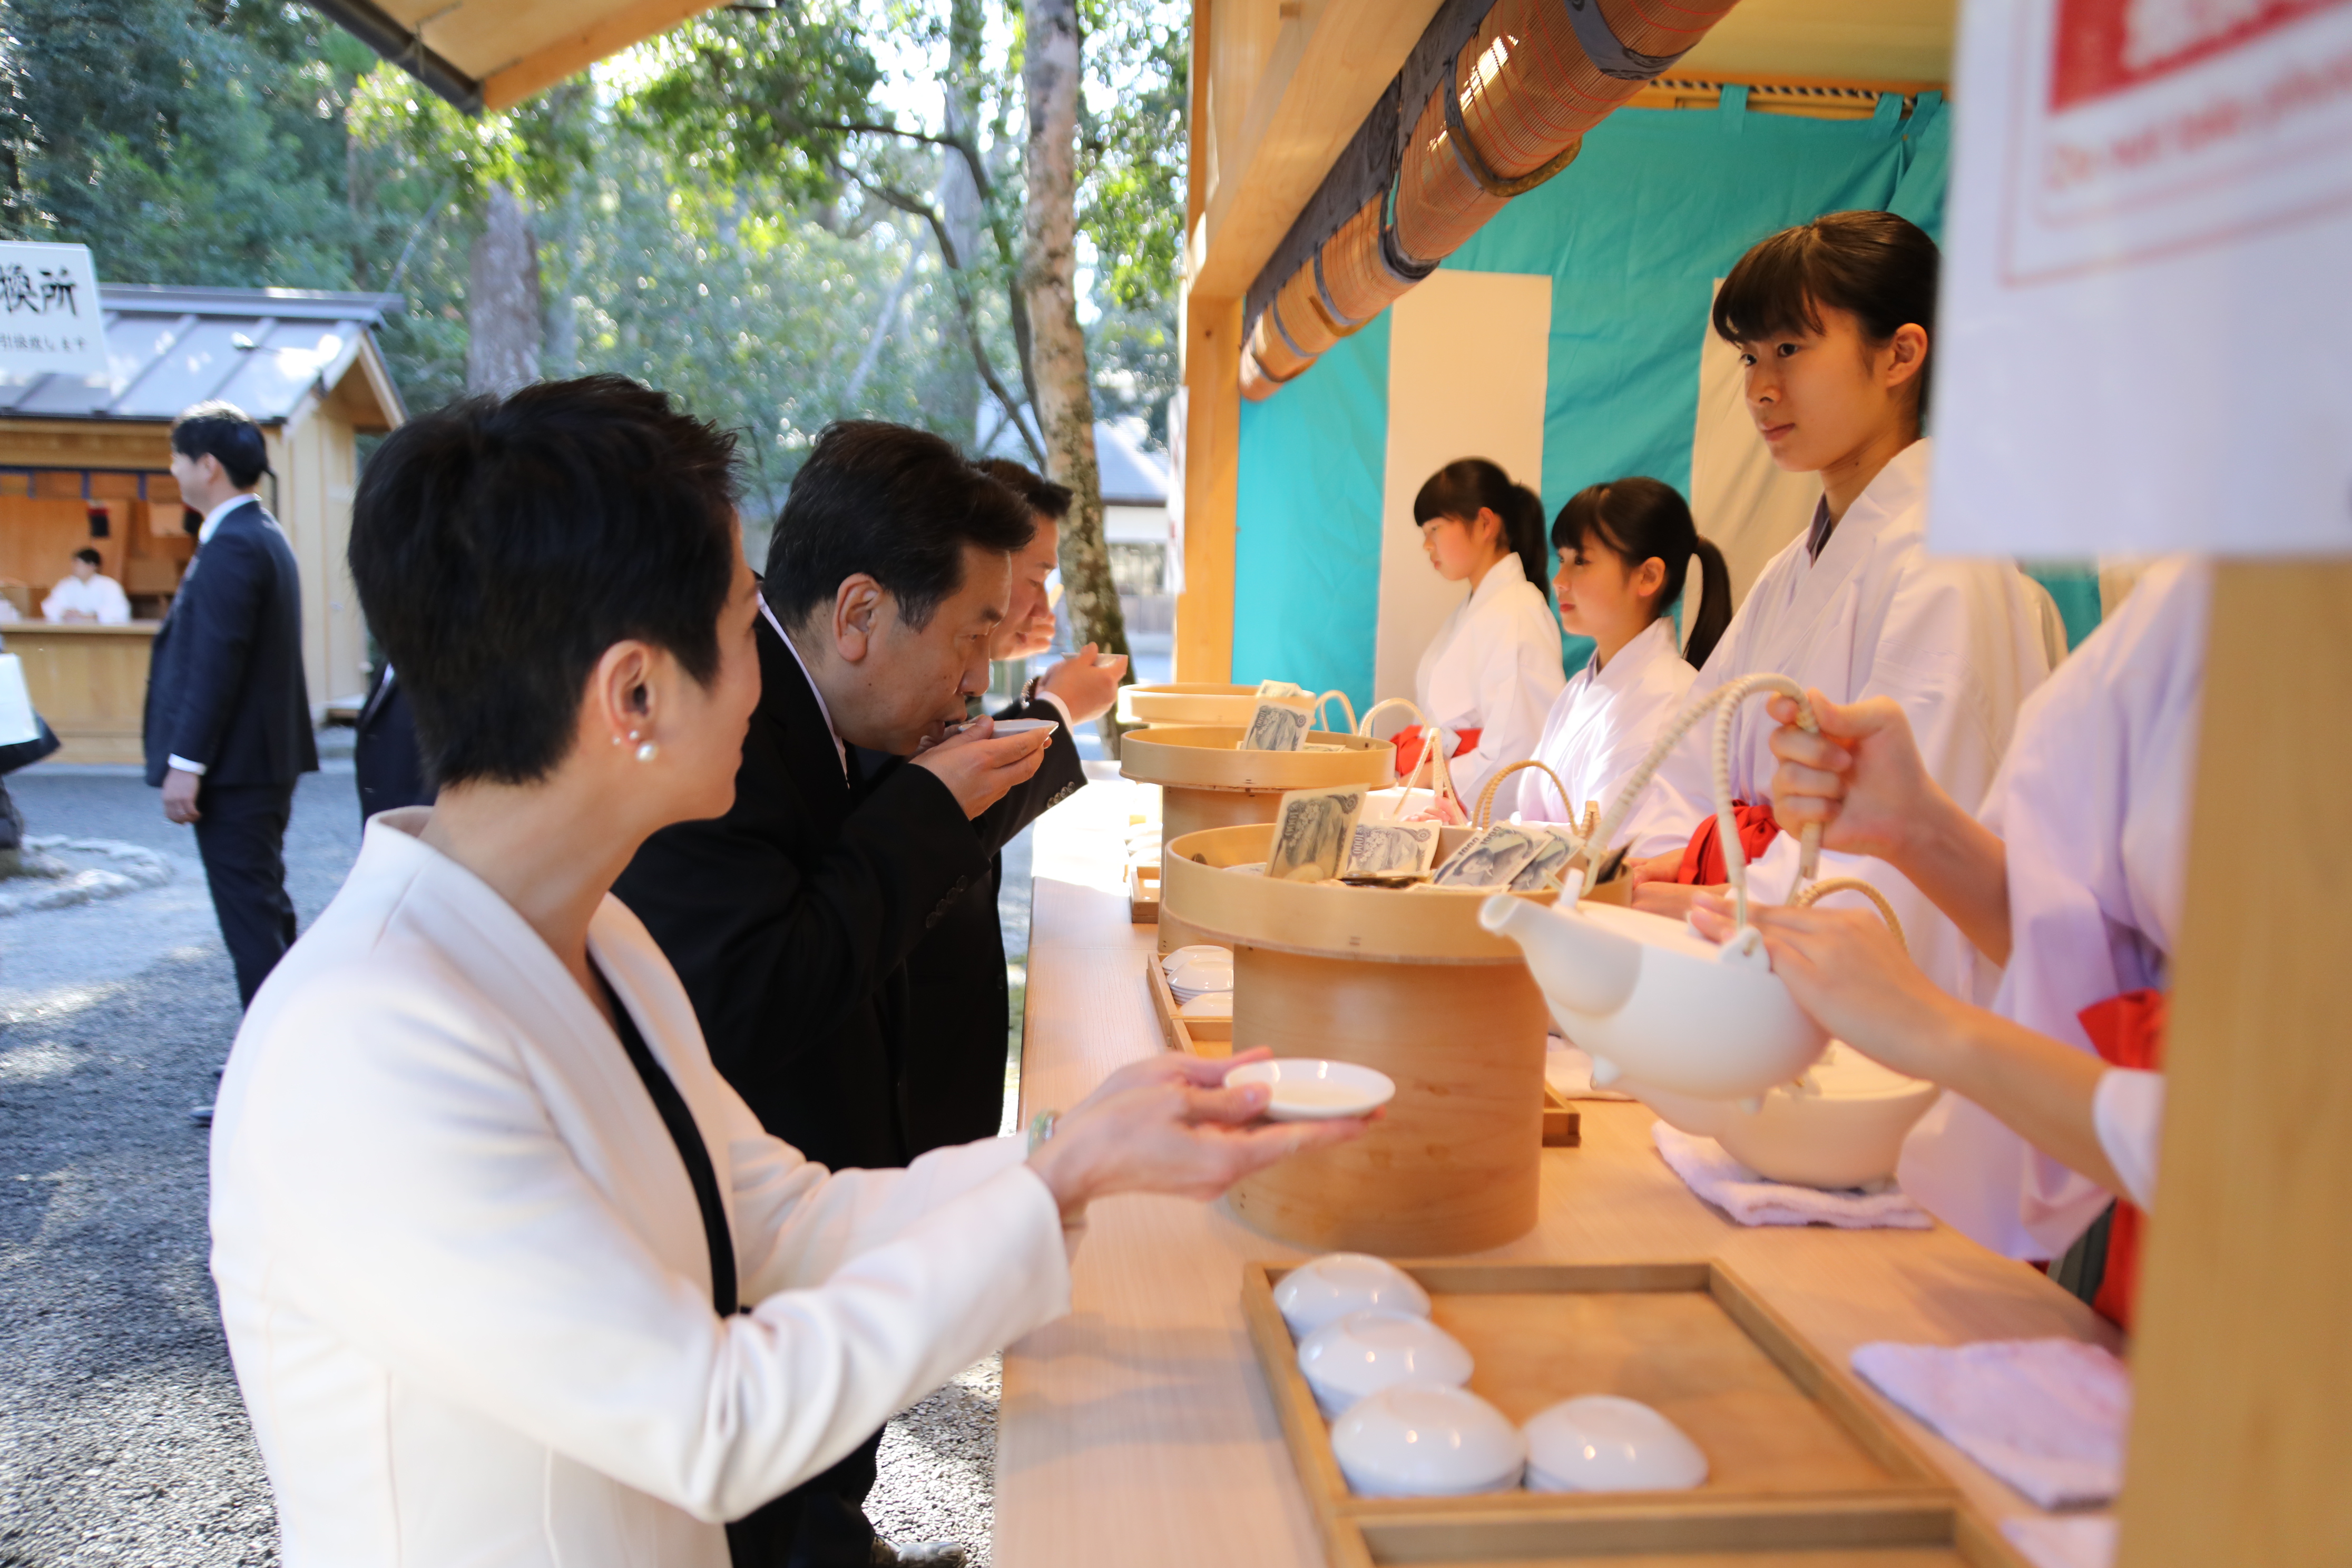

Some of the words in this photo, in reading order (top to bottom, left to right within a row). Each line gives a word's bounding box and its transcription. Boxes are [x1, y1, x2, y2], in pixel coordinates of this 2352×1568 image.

[1285, 811, 1299, 836] 1000
[1353, 835, 1364, 854] 1000
[1480, 826, 1502, 845] 1000
[1458, 837, 1479, 856] 1000
